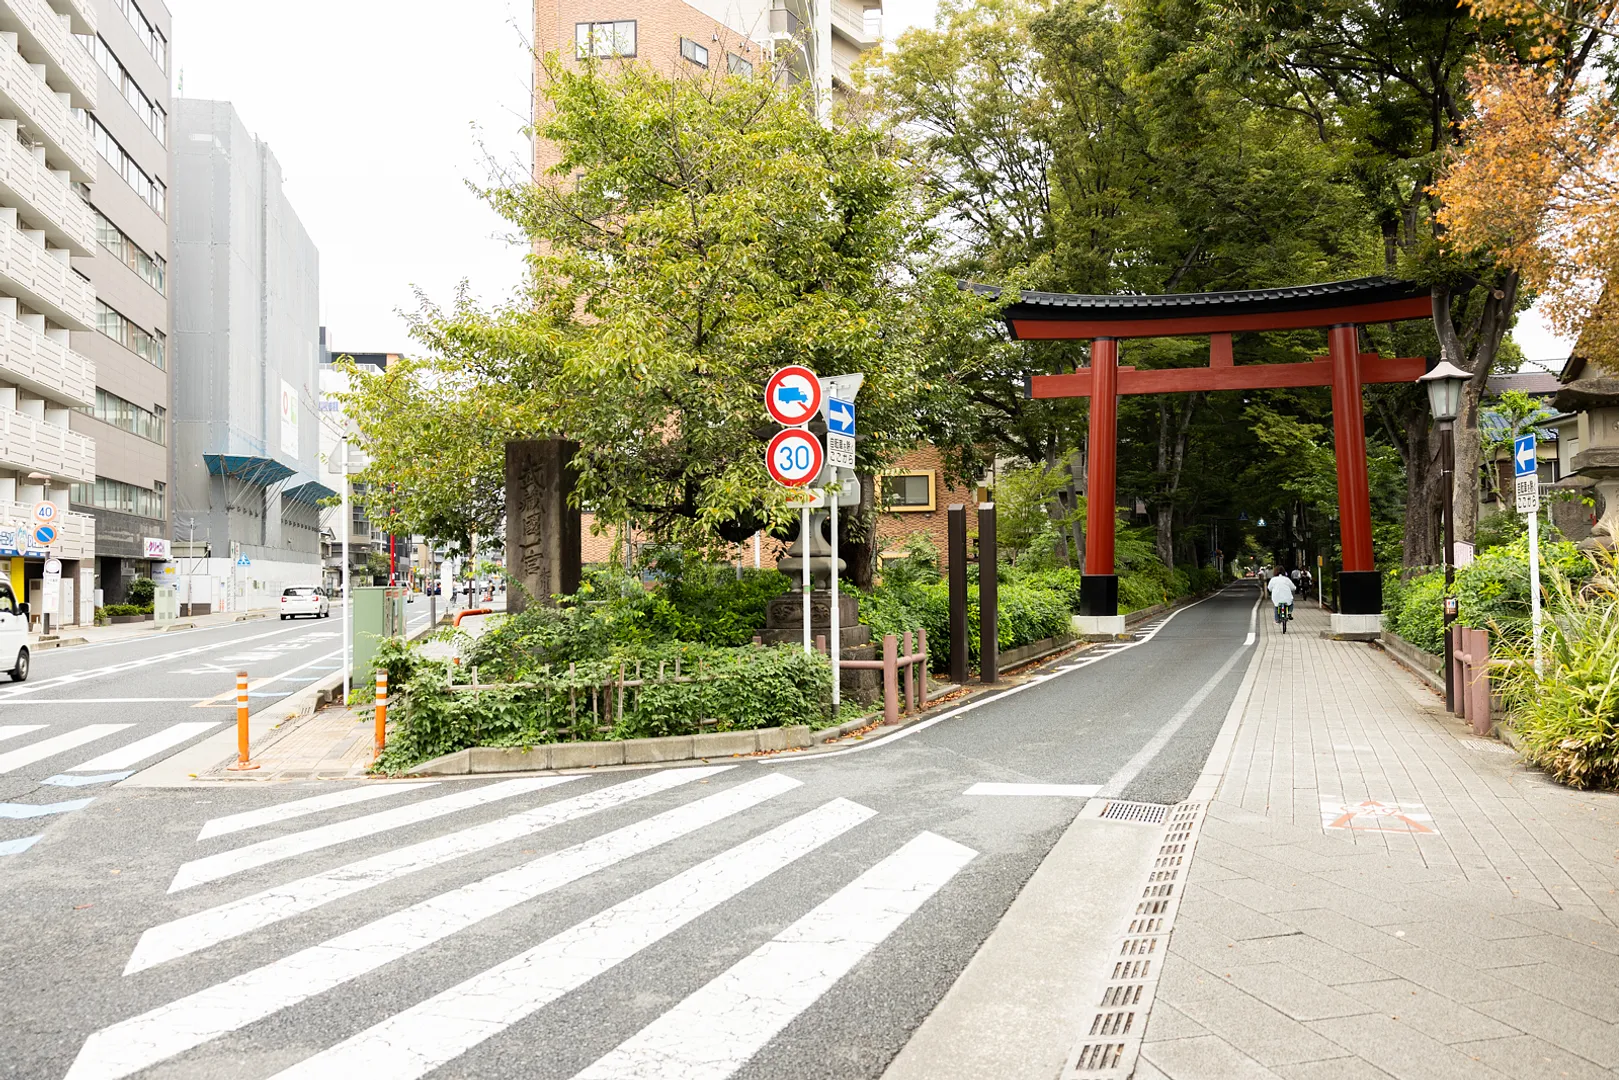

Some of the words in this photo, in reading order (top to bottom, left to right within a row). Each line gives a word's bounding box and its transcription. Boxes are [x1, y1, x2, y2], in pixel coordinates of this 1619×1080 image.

[780, 445, 809, 471] 30
[830, 451, 853, 465] ここから
[1518, 495, 1536, 508] ここから
[38, 507, 52, 517] 40
